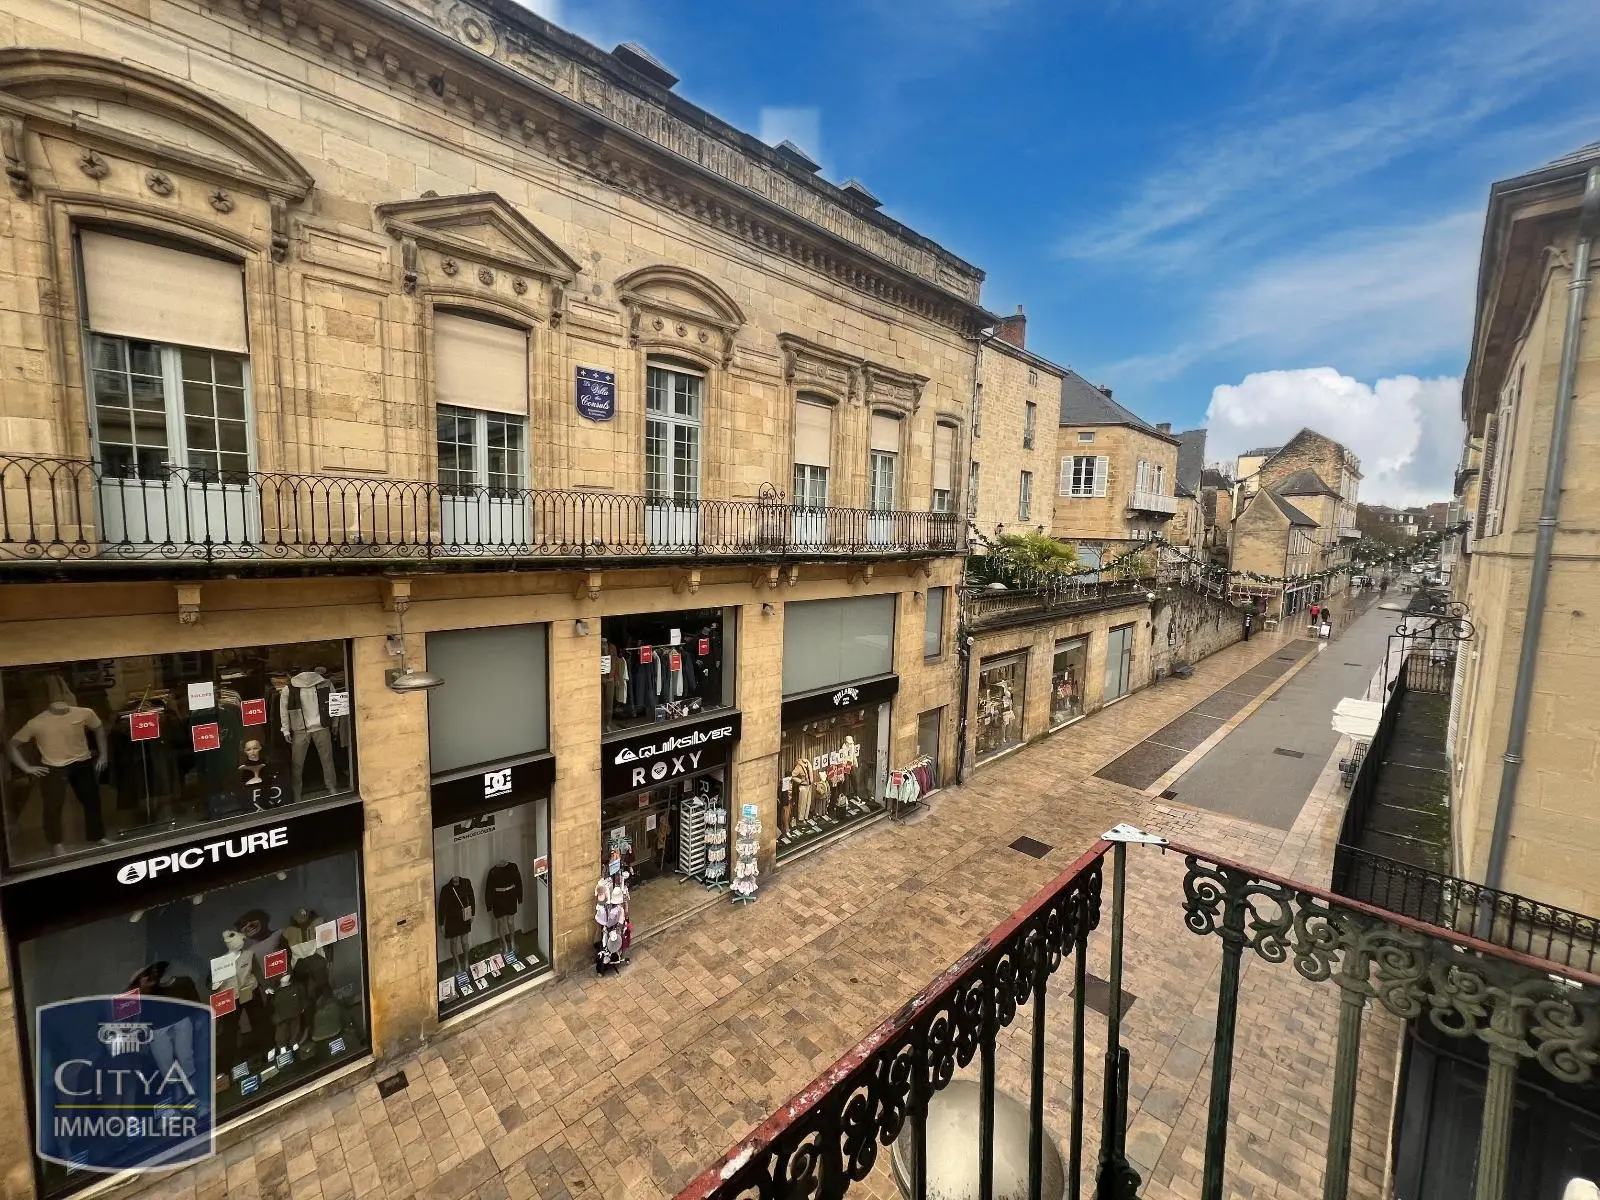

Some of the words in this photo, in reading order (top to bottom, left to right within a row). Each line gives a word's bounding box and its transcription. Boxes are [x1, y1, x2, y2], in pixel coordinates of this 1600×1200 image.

[580, 394, 611, 409] Consuls
[639, 726, 733, 758] QUIKSILVER
[632, 750, 702, 787] ROXY
[149, 826, 289, 879] PICTURE
